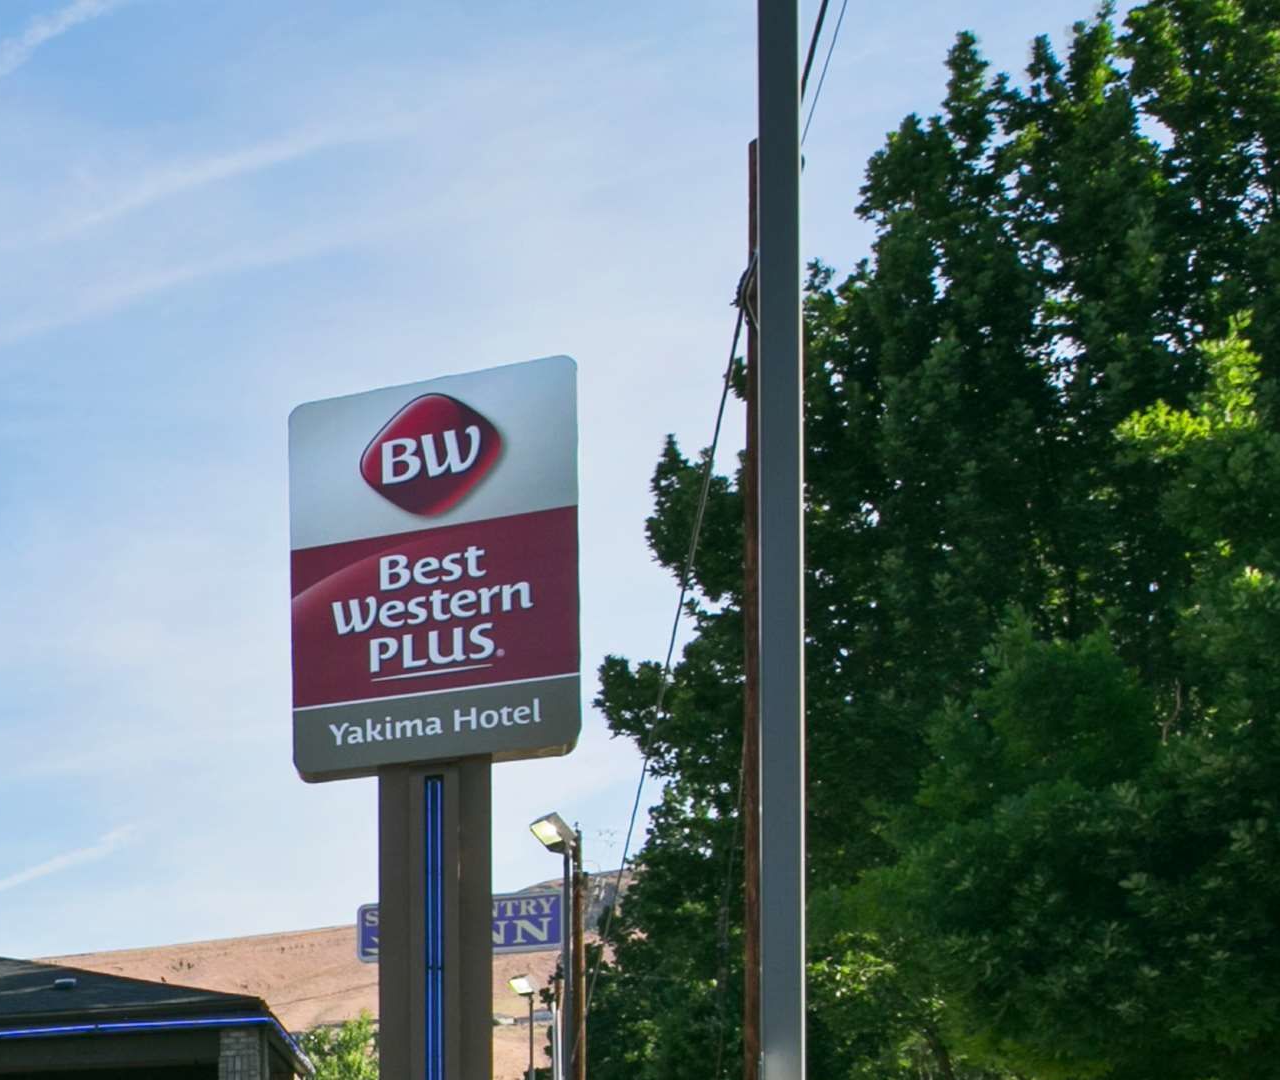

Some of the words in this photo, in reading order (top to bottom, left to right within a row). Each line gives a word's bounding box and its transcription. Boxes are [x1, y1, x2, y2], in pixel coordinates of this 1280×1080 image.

[380, 424, 482, 486] BW
[378, 545, 488, 592] Best
[331, 580, 535, 636] Western
[368, 622, 496, 674] PLUS
[328, 716, 444, 747] Yakima
[452, 698, 542, 733] Hotel
